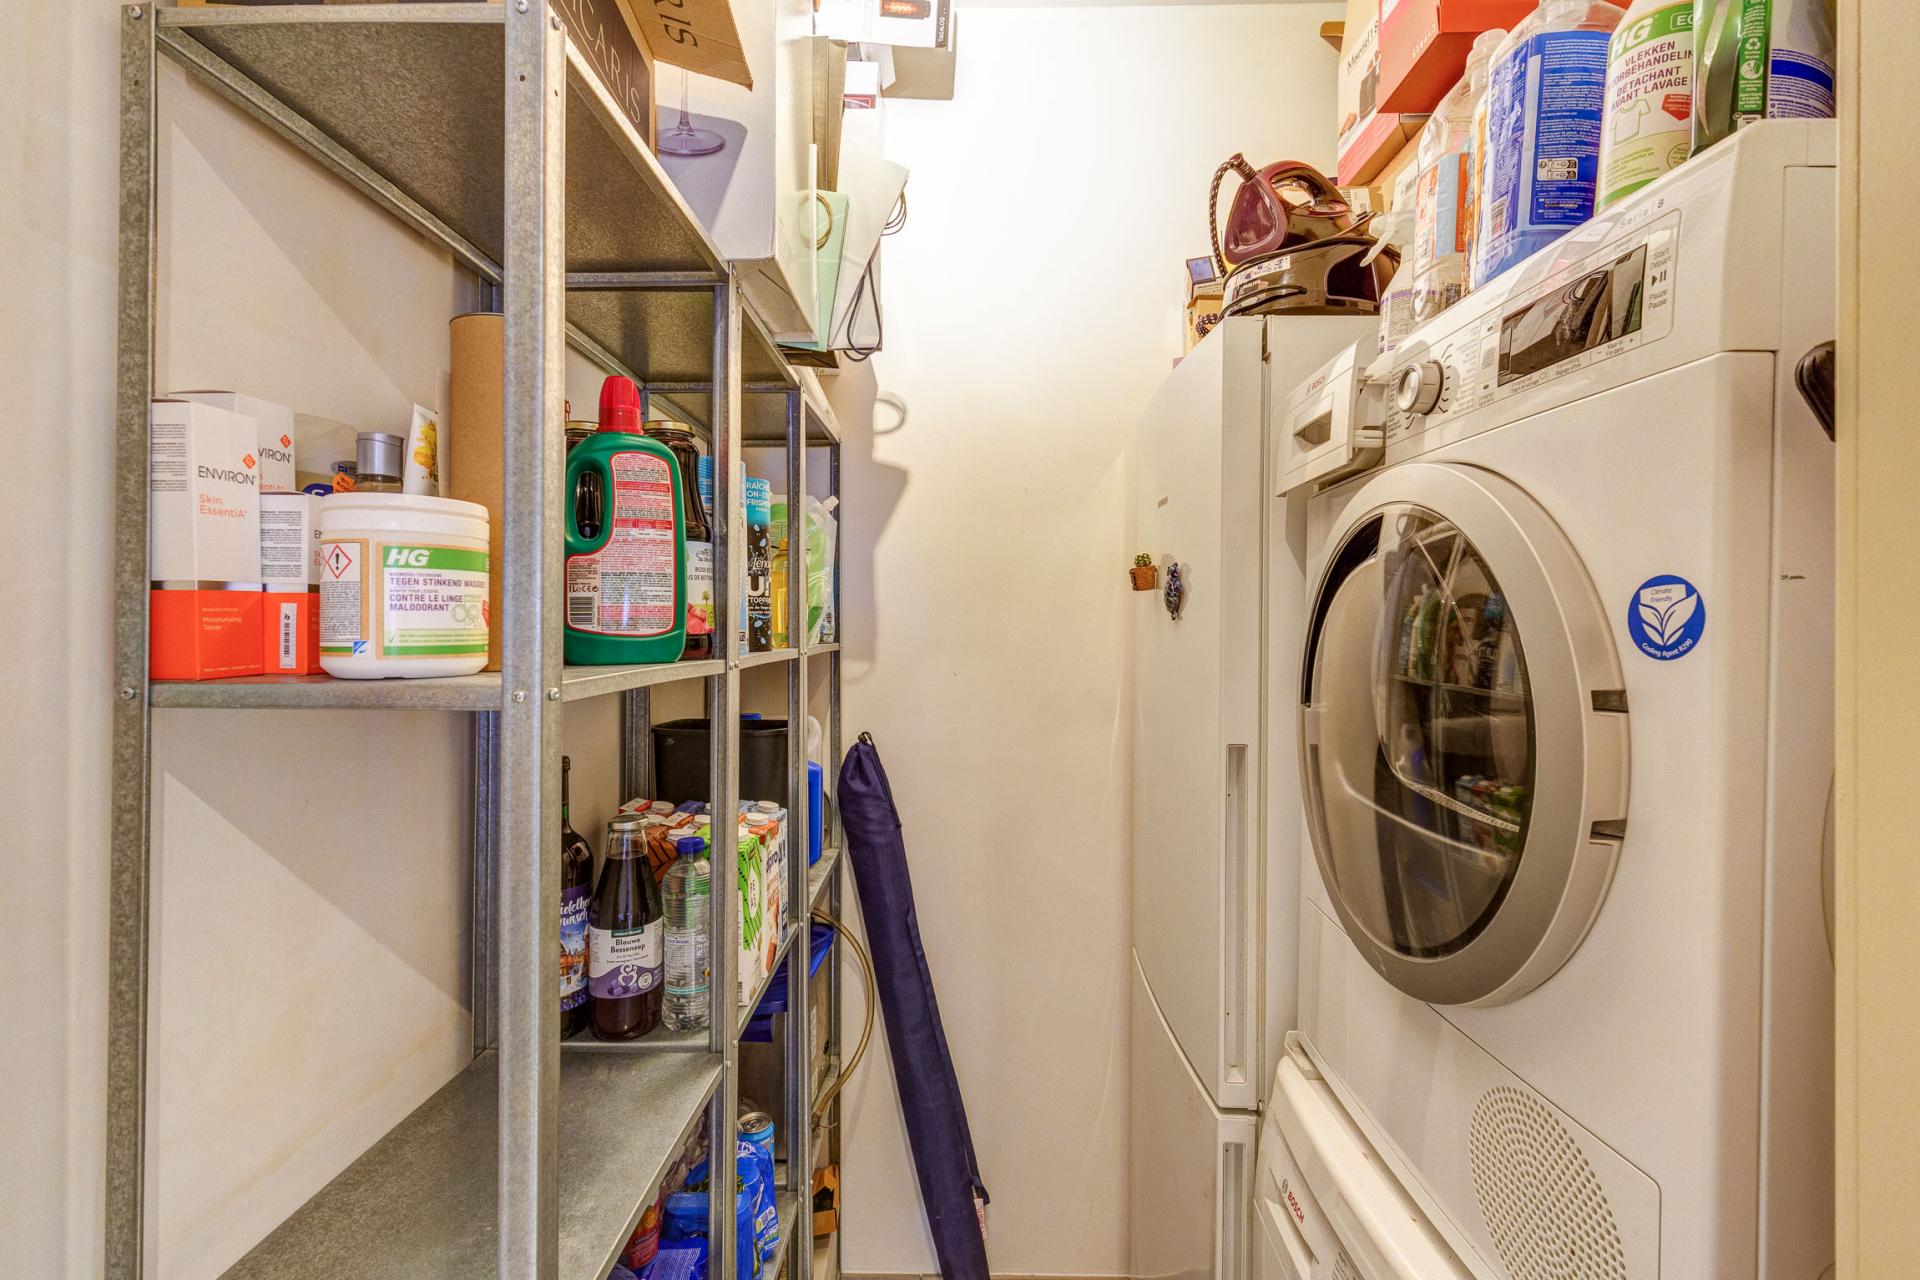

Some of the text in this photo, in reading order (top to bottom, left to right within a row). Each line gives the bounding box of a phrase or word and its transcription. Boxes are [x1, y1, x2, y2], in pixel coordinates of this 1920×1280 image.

[1609, 17, 1654, 64] HG
[1624, 40, 1676, 67] VLEKKEN
[1616, 66, 1682, 97] DÉTACHANT
[1644, 76, 1689, 94] LAVAGE
[258, 447, 292, 464] VIRON
[197, 465, 257, 486] ENVIRON
[199, 493, 223, 505] Skin
[386, 548, 431, 567] HG
[390, 577, 420, 586] TEGEN
[422, 578, 462, 588] STINKEND
[389, 593, 463, 603] CONTRE LE LINGE
[389, 603, 450, 612] MALODORANT
[559, 896, 591, 915] idelbe
[559, 909, 589, 926] unsch
[610, 943, 646, 954] Bessensap
[615, 938, 641, 946] Blauwe
[1287, 1190, 1305, 1224] BOSCH
